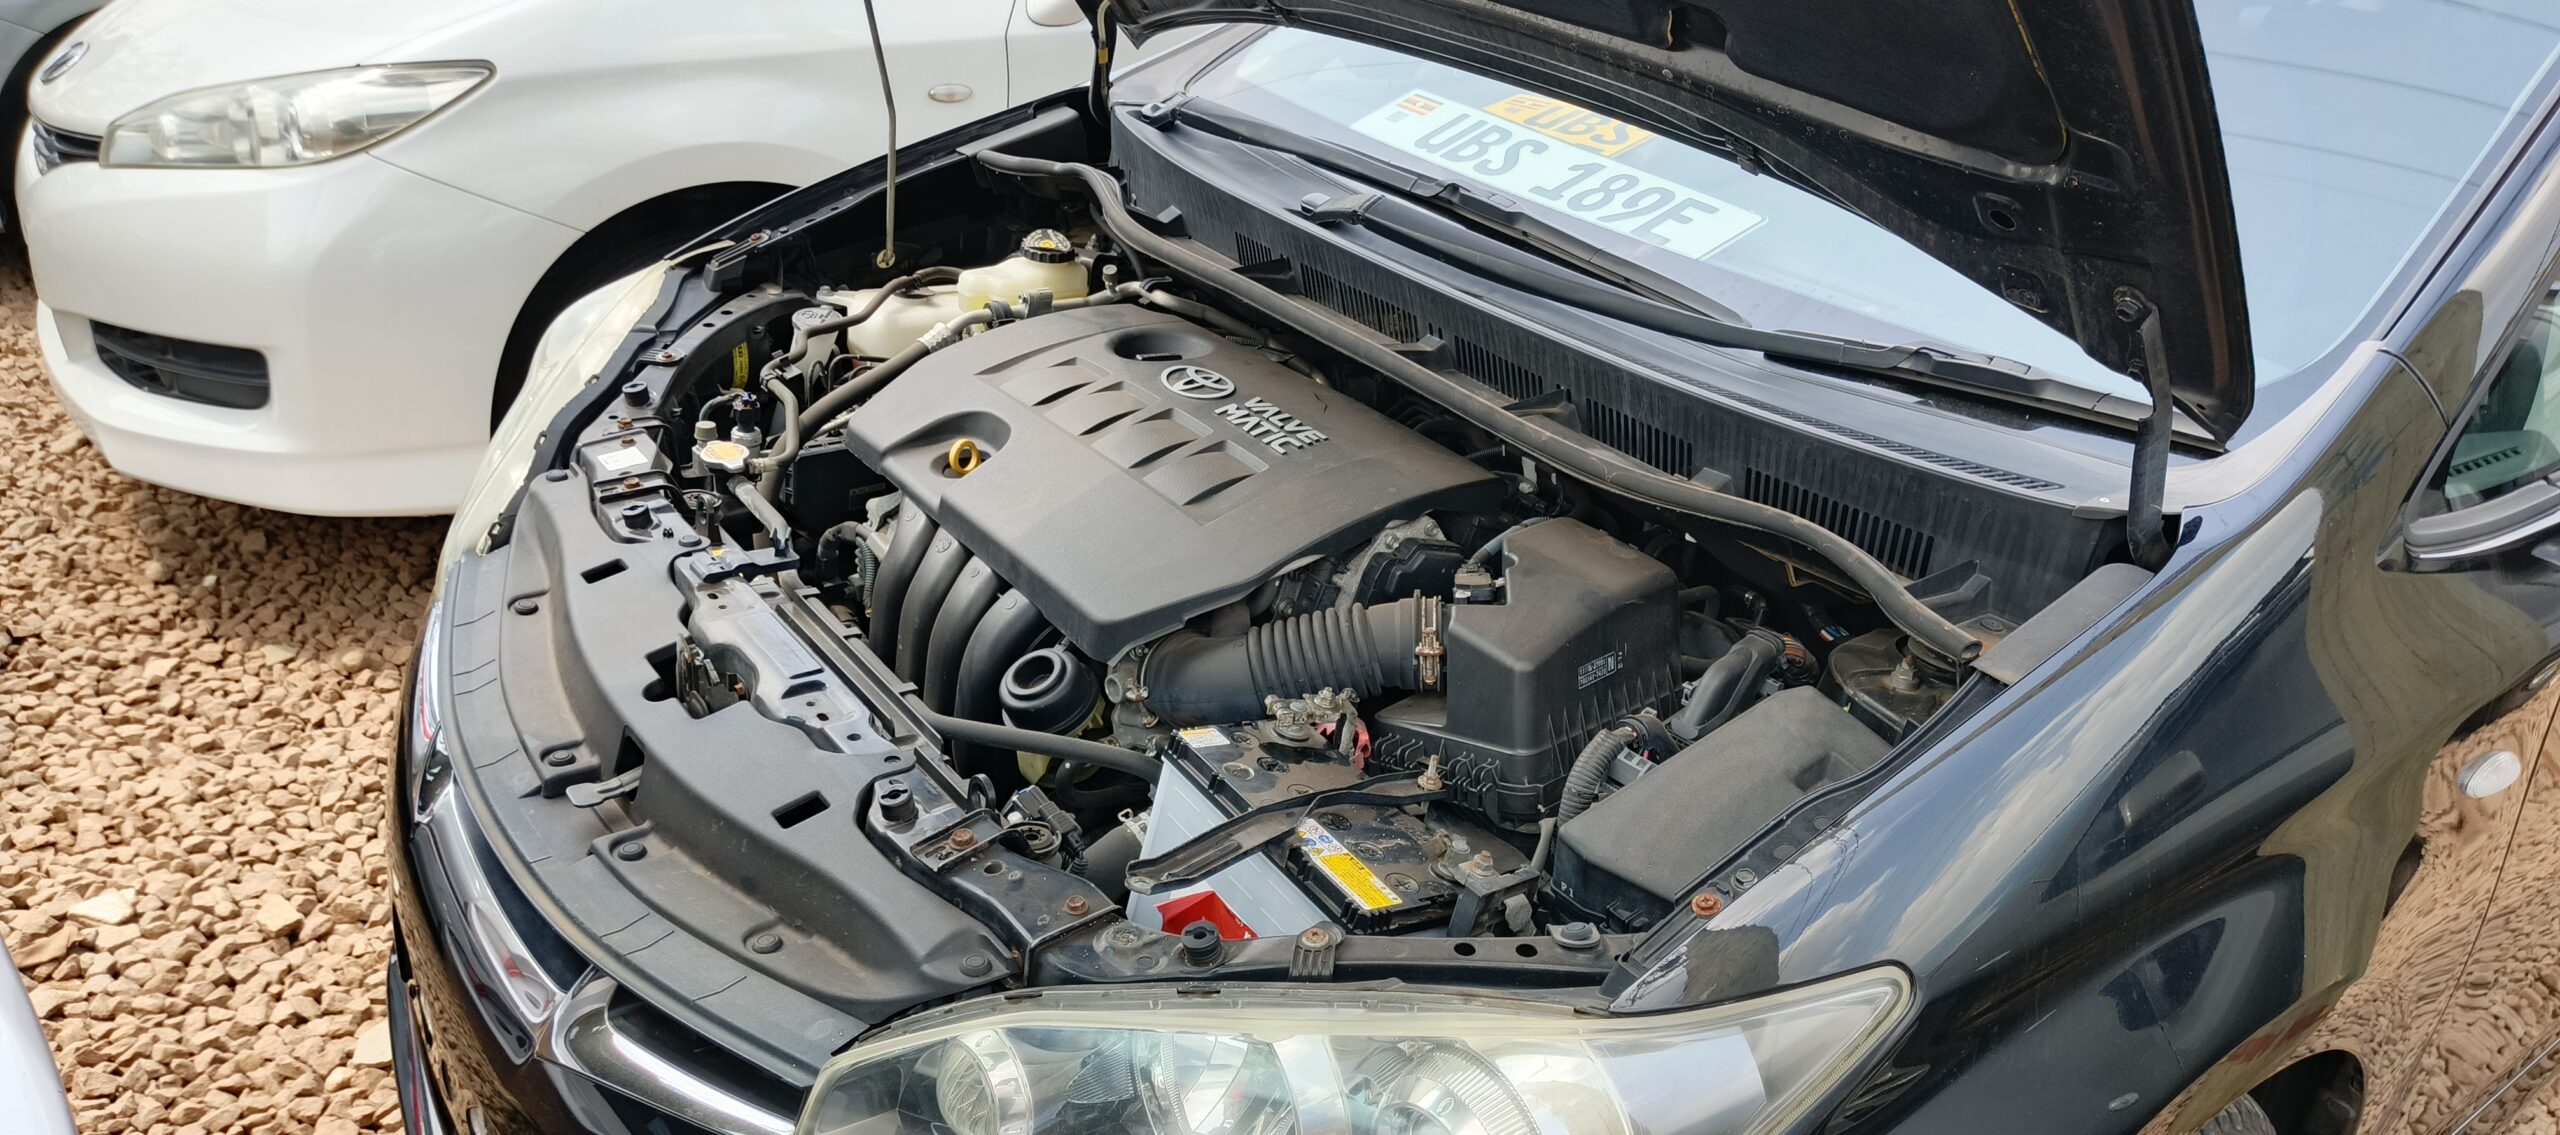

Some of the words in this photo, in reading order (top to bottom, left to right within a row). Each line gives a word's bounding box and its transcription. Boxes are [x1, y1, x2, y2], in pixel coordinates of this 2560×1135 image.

[1523, 106, 1630, 145] UBS
[1414, 113, 1549, 177] UBS
[1529, 162, 1720, 247] 189E
[1213, 402, 1304, 456] MATIC
[1244, 396, 1329, 446] VALVE
